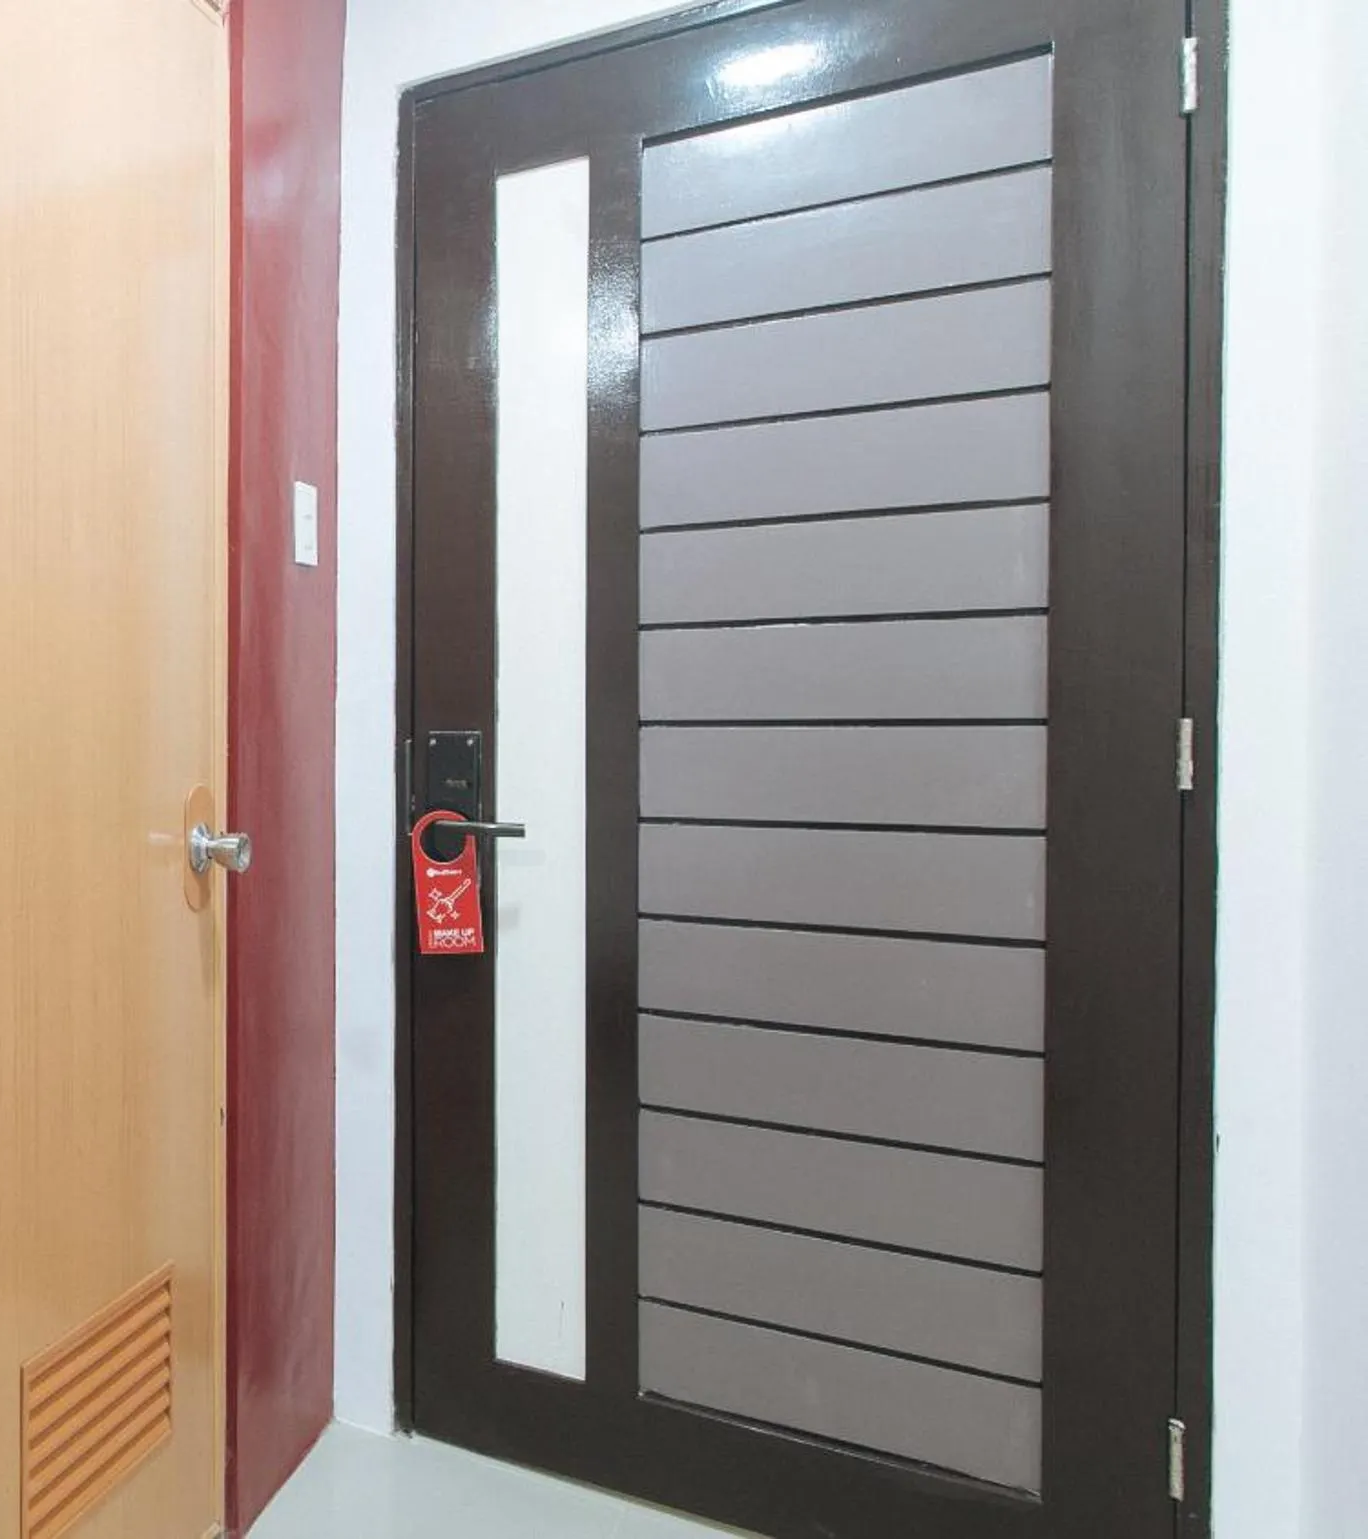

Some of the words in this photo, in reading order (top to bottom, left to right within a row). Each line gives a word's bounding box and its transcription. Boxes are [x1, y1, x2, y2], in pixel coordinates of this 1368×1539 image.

[433, 927, 460, 937] MAKE
[461, 927, 475, 937] UP
[433, 936, 477, 949] ROOM
